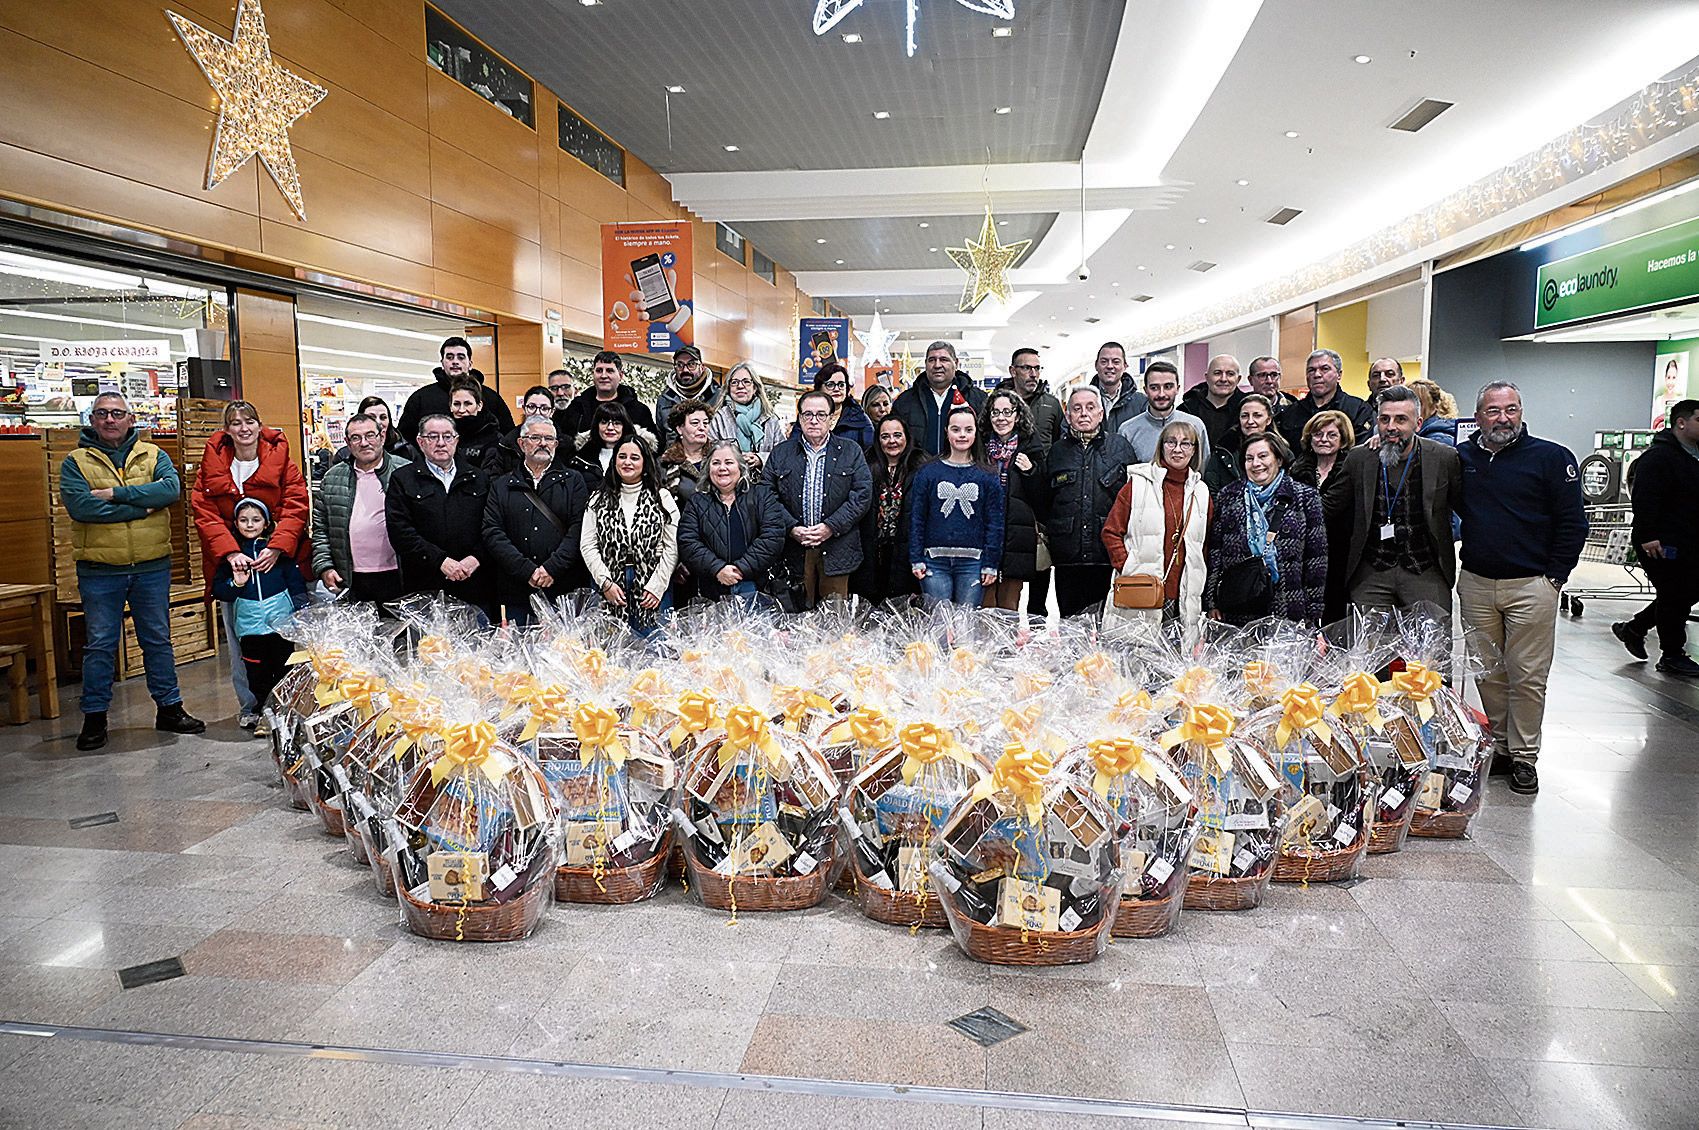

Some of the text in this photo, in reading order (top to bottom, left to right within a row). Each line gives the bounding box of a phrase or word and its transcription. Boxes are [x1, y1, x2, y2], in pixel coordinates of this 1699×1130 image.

[1647, 254, 1686, 272] Hacemos
[1688, 249, 1696, 262] la
[74, 347, 108, 358] RIOJA
[110, 347, 158, 358] CRIANZA
